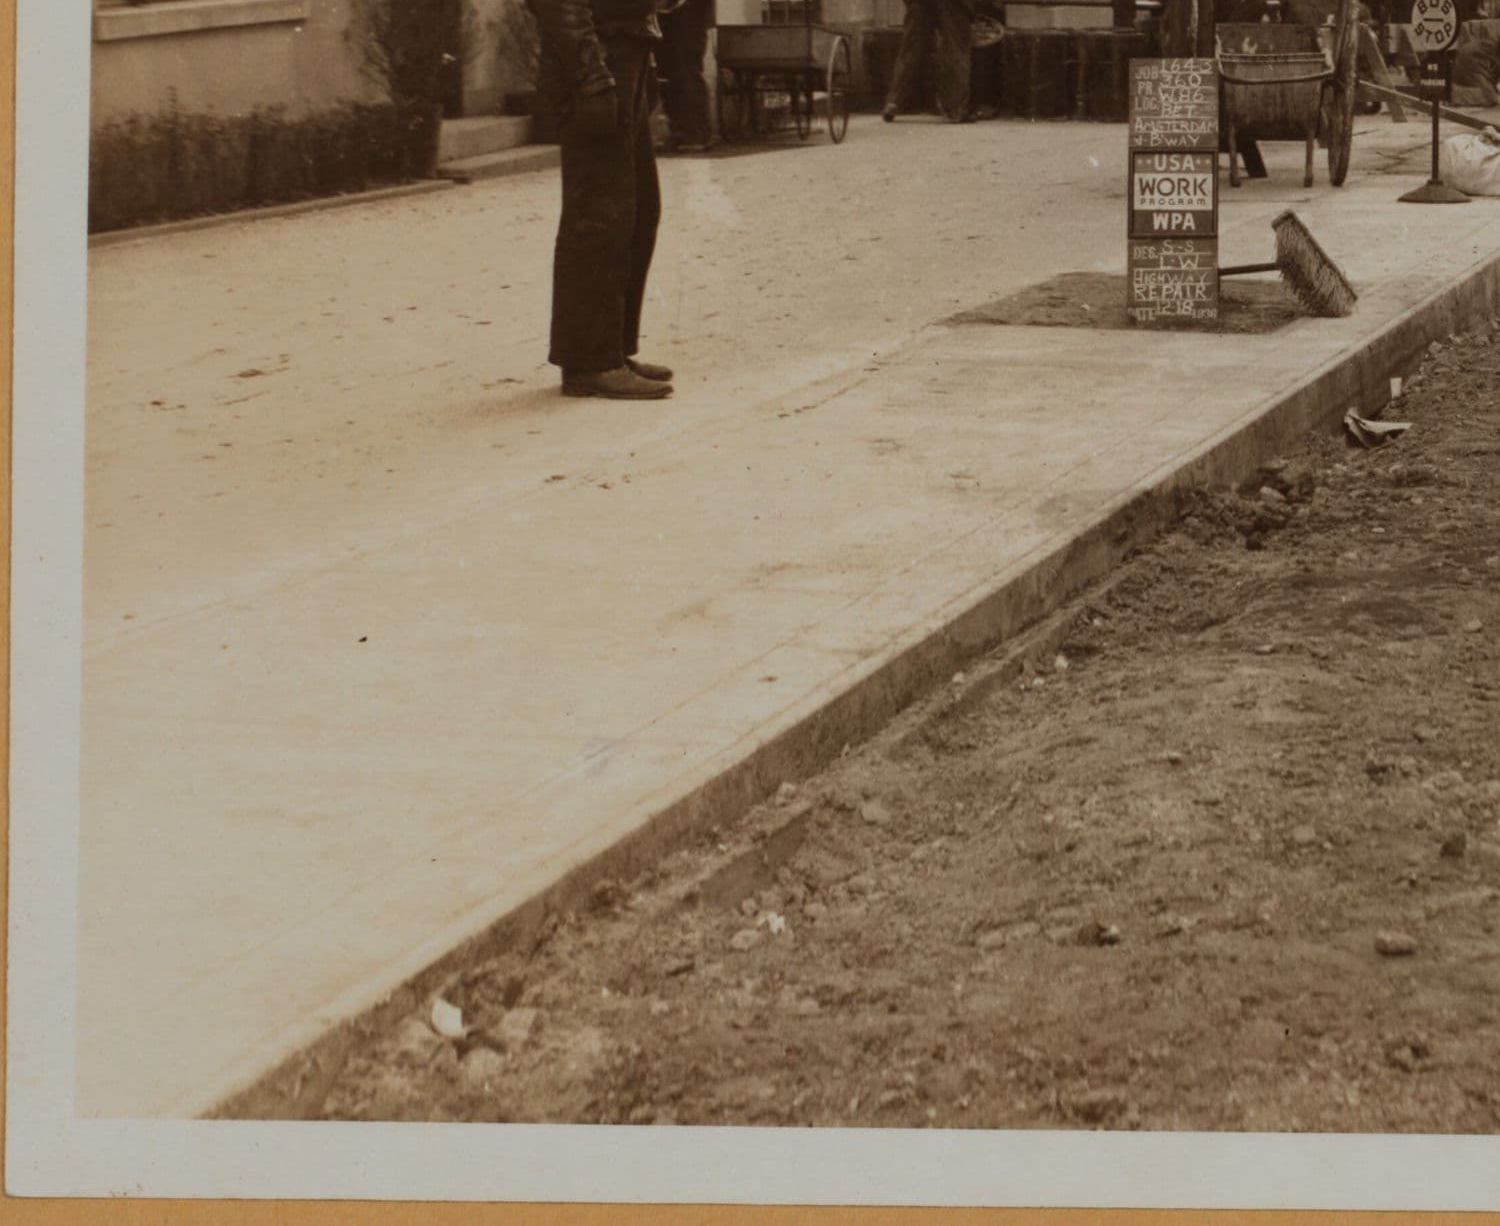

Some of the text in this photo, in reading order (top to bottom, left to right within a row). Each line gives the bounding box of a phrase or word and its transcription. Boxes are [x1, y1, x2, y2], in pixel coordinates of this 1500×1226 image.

[1414, 22, 1452, 44] STOP
[1134, 65, 1158, 79] JOB
[1153, 153, 1196, 172] USA
[1138, 177, 1209, 198] WORK
[1139, 197, 1208, 207] PROGRAM
[1153, 212, 1196, 231] WPA
[1133, 269, 1209, 286] HIGHWAY
[1134, 284, 1207, 302] REPAIR
